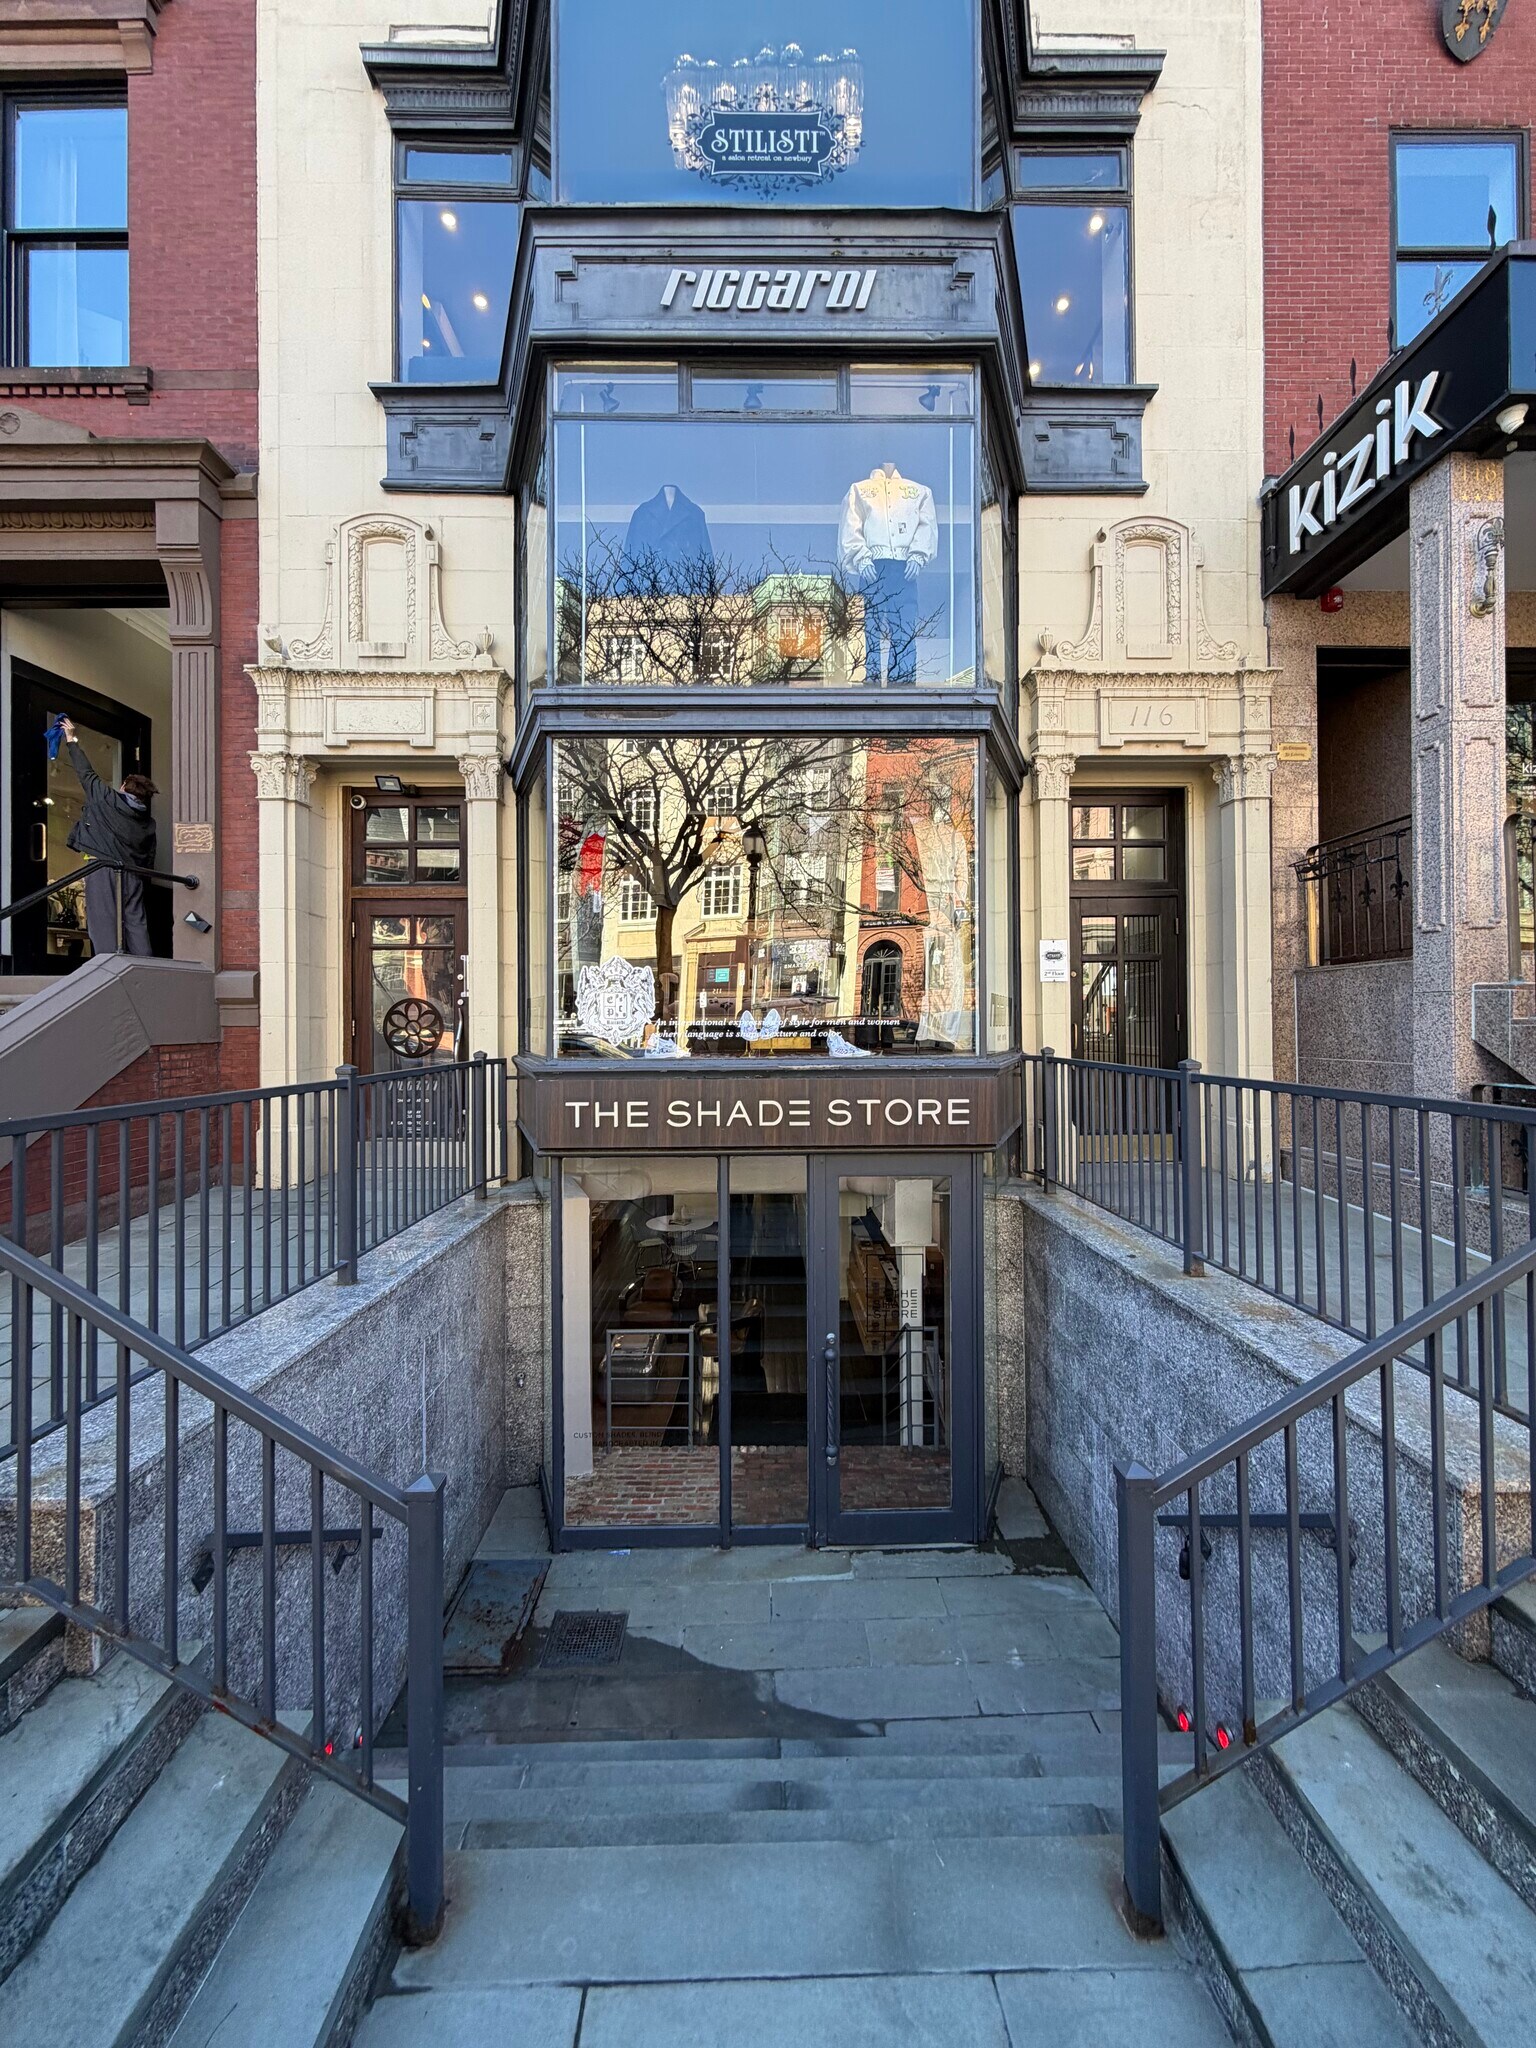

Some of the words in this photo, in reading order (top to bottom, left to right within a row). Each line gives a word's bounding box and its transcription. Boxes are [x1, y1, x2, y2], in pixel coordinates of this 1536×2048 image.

[711, 128, 820, 154] STILISTI
[728, 153, 746, 162] salon
[747, 153, 772, 162] retreat
[784, 153, 813, 164] newbury
[1288, 371, 1443, 555] kizik
[1130, 704, 1173, 727] 116
[655, 1017, 667, 1026] An
[779, 1017, 788, 1028] of
[789, 1017, 809, 1028] style
[809, 1017, 826, 1028] for
[826, 1018, 847, 1026] men
[848, 1017, 865, 1026] and
[867, 1018, 900, 1026] women
[685, 1029, 724, 1040] language
[725, 1029, 734, 1038] is
[799, 1029, 816, 1038] and
[565, 1101, 649, 1128] THE
[667, 1100, 811, 1127] SHADE
[827, 1098, 970, 1126] STORE
